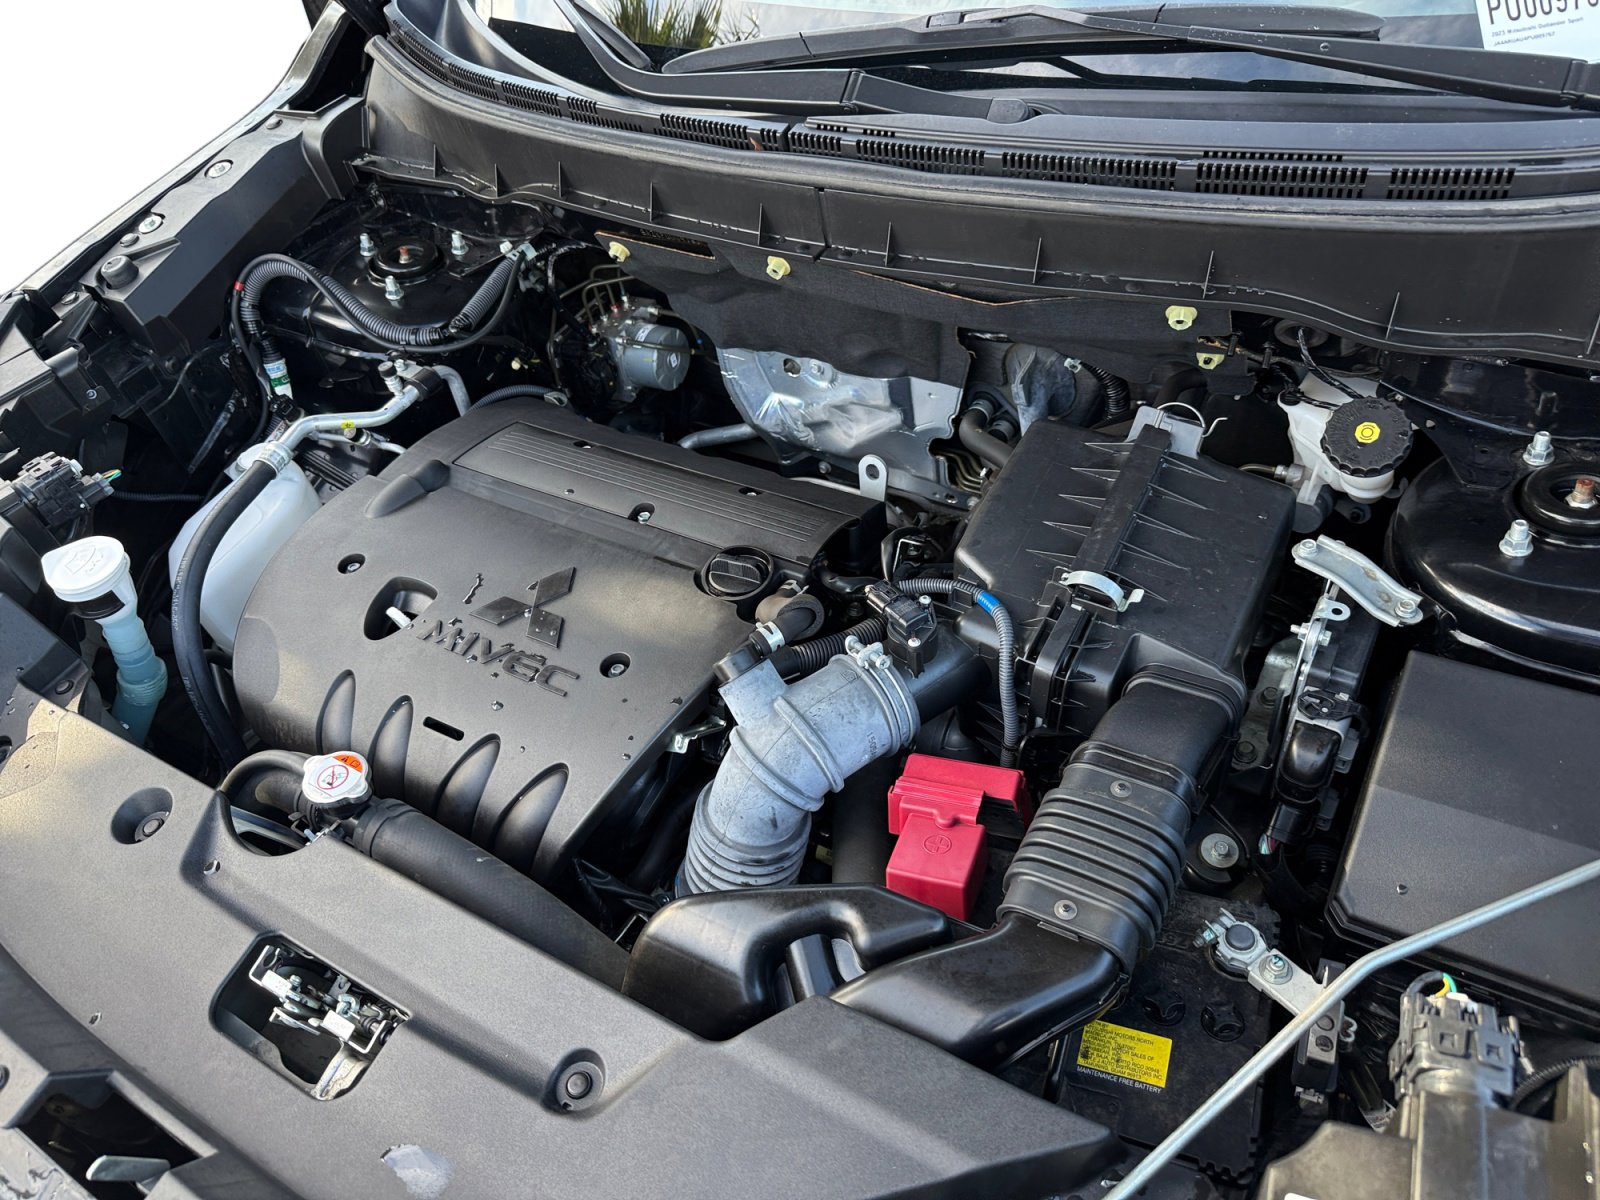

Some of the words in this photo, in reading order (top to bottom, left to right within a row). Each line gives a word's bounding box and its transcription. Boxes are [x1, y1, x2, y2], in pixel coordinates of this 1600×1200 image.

[416, 619, 580, 697] MIVEC
[1114, 1031, 1135, 1041] MOTORS
[1077, 1066, 1117, 1083] MAINTENANCE
[1119, 1077, 1133, 1087] FREE
[1135, 1080, 1162, 1094] BATTERY
